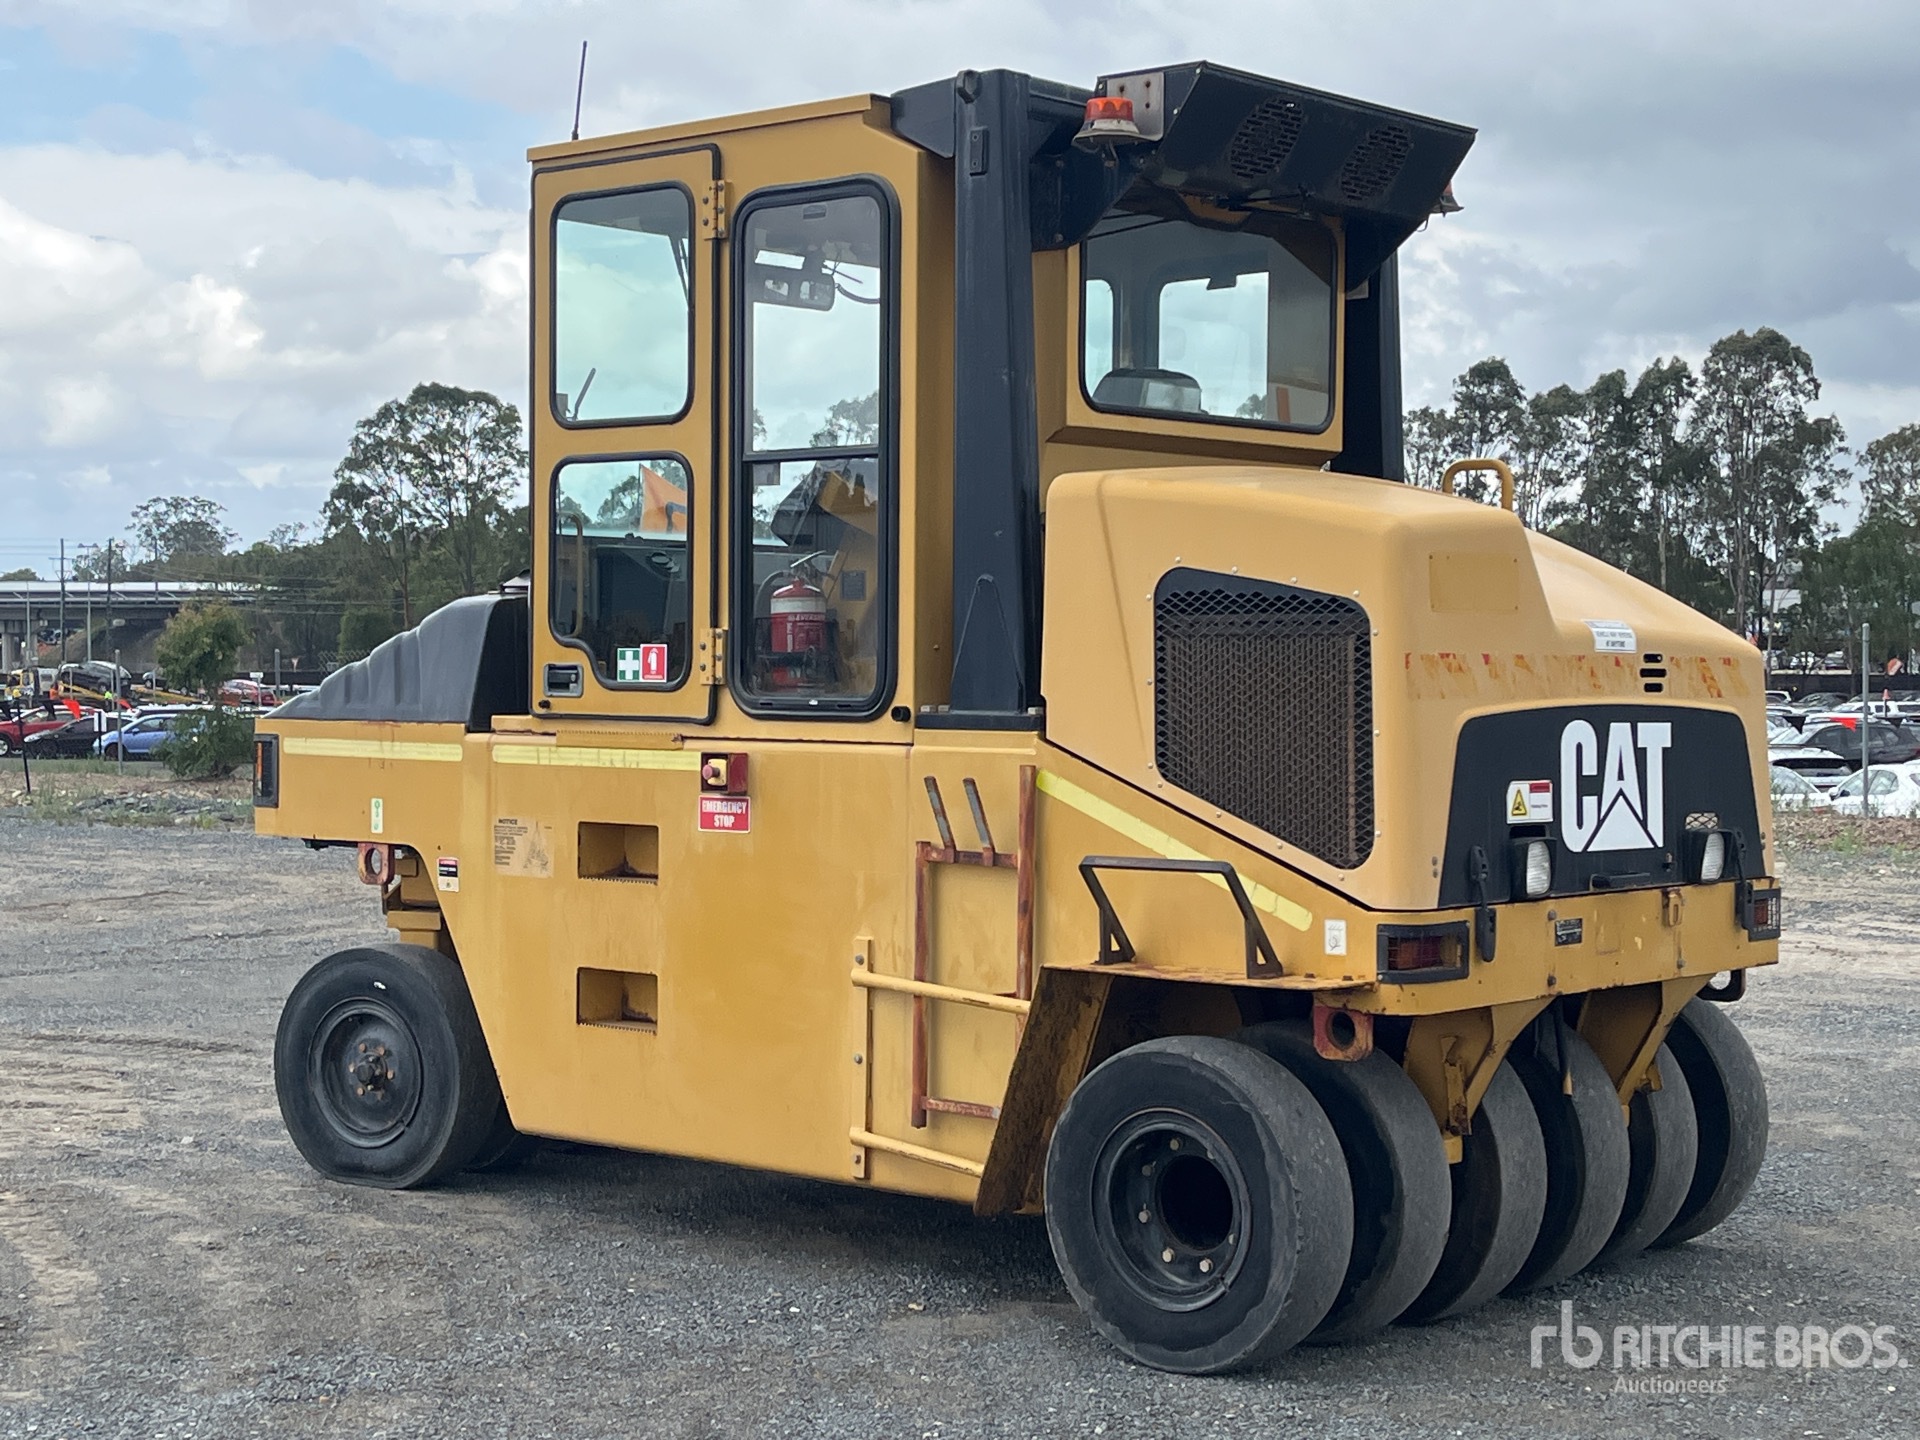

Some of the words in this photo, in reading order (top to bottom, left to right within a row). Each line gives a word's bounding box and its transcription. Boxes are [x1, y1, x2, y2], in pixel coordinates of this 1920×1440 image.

[1560, 719, 1672, 852] CAT
[702, 800, 747, 814] EMERGENCY
[713, 815, 735, 828] STOP
